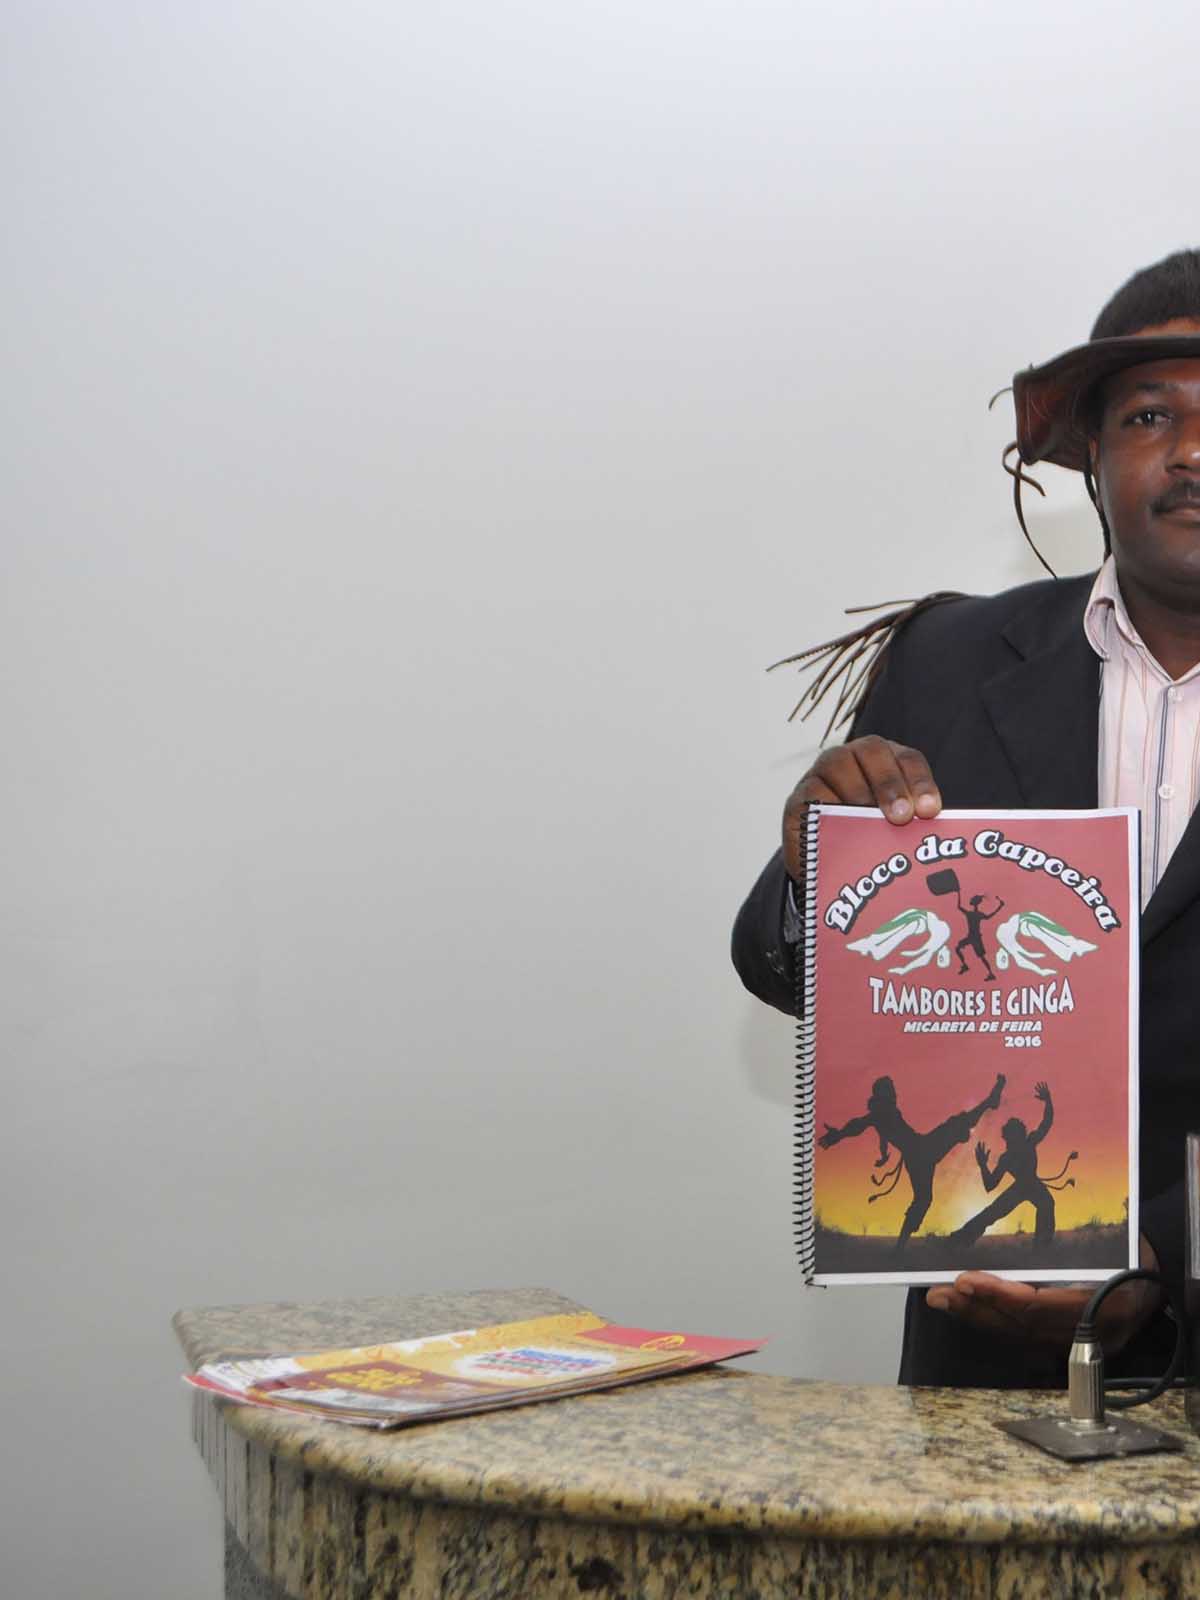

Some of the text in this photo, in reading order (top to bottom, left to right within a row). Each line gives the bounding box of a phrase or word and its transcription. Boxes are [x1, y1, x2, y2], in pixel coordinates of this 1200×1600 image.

[824, 829, 1121, 934] Bloco da Capoeira
[868, 976, 1075, 1017] TAMBORES E GINGA
[903, 1020, 1043, 1034] MICARETA DE FEIRA
[1003, 1035, 1042, 1048] 2016
